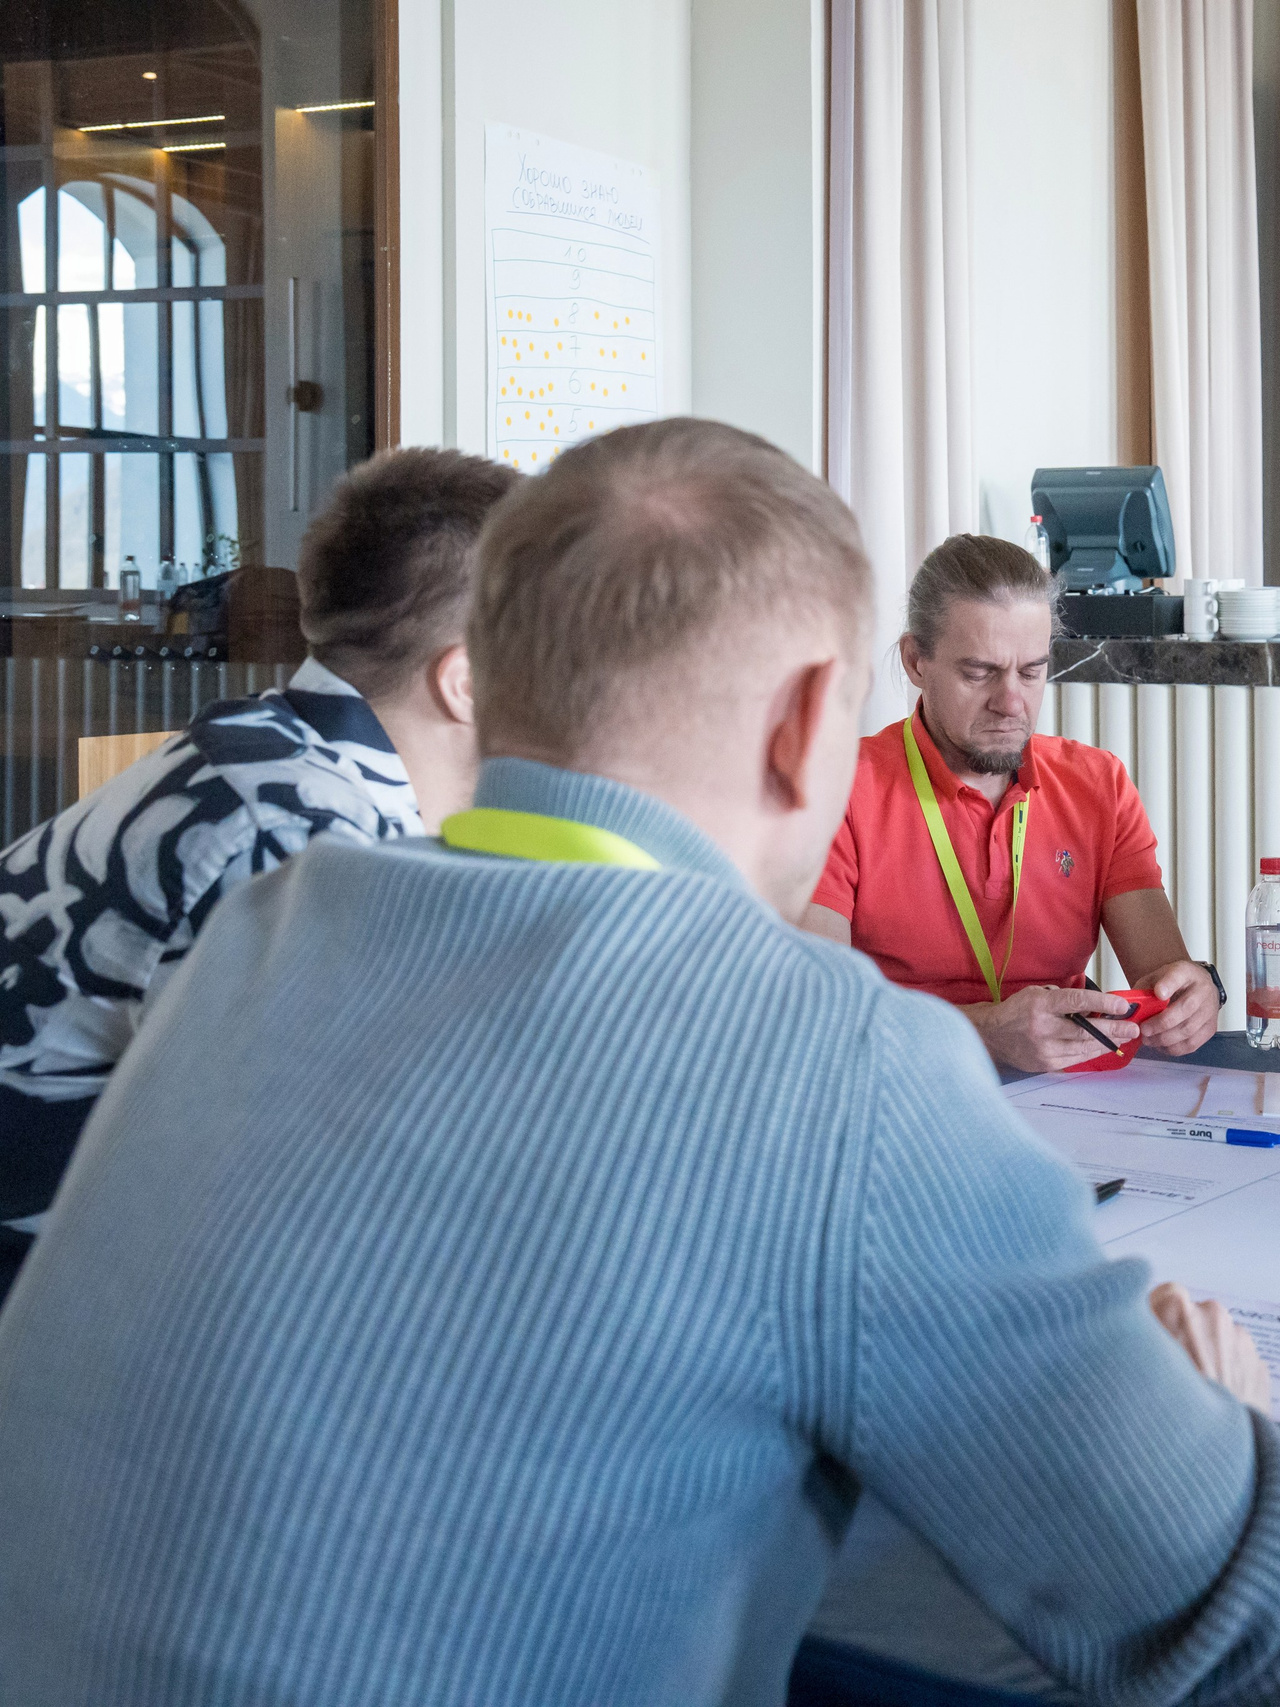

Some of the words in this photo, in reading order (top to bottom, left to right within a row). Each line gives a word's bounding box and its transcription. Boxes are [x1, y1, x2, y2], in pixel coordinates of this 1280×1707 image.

[563, 245, 588, 263] 10
[568, 267, 581, 290] 9
[568, 301, 580, 325] 8
[568, 334, 582, 358] 7
[568, 369, 581, 394] 6
[568, 407, 582, 433] 5
[1188, 1129, 1213, 1140] buro
